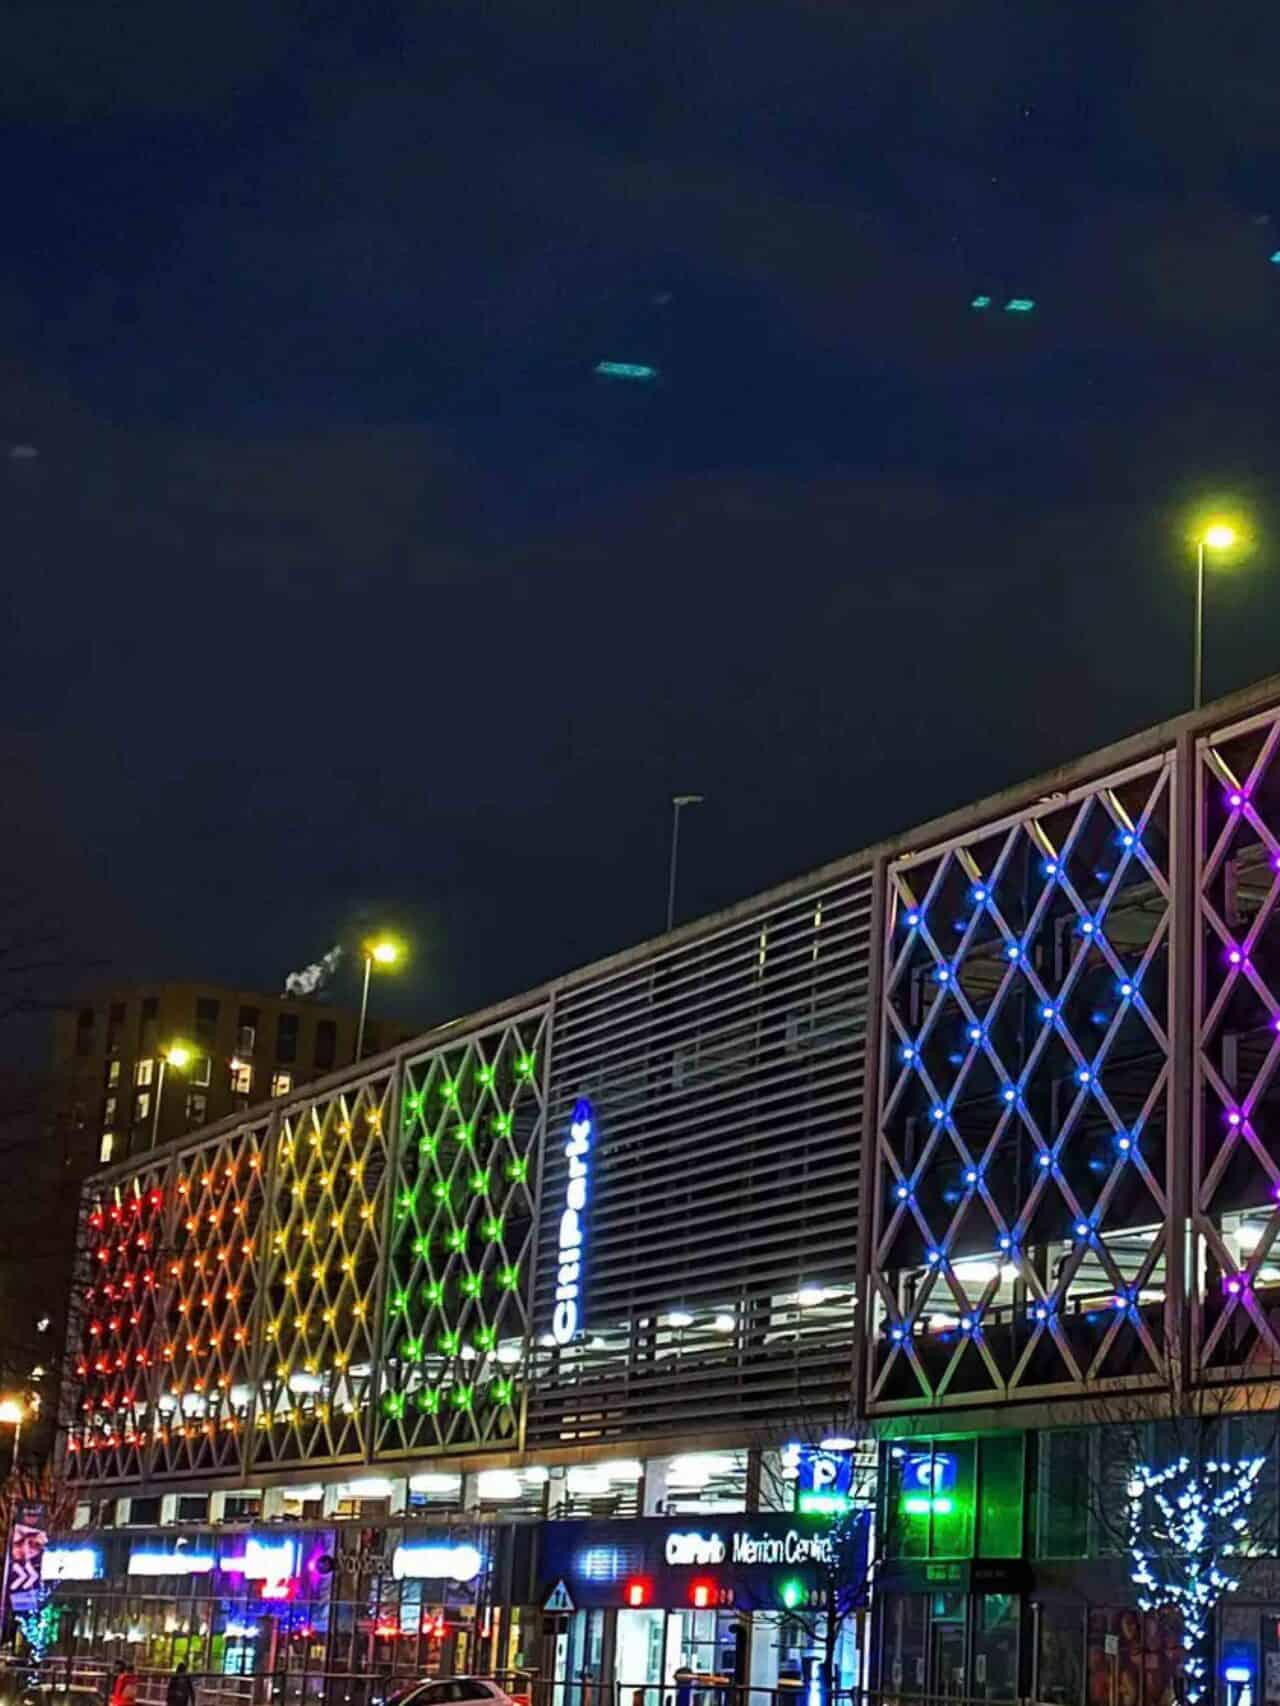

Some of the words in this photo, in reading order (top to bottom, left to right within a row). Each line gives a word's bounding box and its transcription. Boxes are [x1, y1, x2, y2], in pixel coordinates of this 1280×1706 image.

[552, 1120, 591, 1344] CitiPark
[733, 1532, 784, 1563] Merrion
[786, 1529, 833, 1564] Centre
